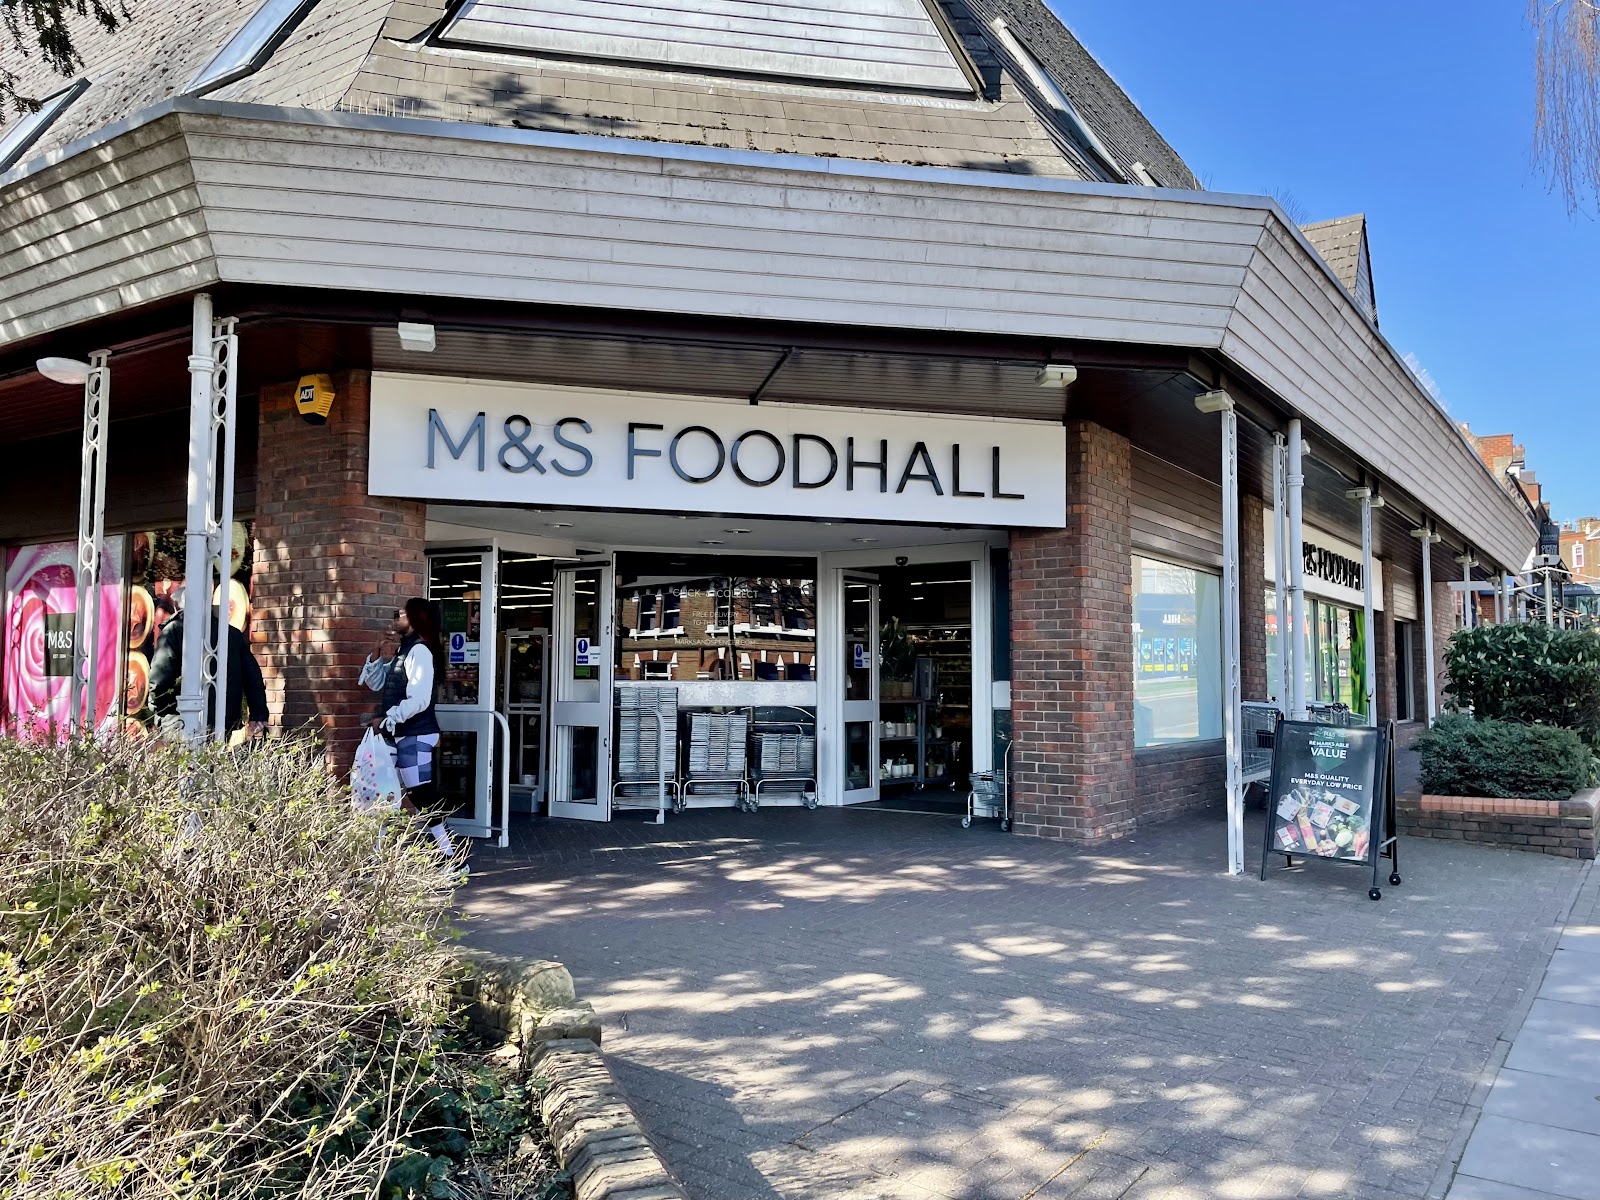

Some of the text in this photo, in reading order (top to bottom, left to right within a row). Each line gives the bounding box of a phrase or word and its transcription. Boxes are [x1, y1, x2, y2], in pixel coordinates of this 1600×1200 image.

[300, 388, 315, 401] ADT
[427, 408, 1025, 499] M&S FOODHALL
[716, 589, 759, 599] COLLECT
[48, 630, 73, 649] M&S
[1310, 746, 1347, 759] VALUE
[1304, 772, 1350, 782] M&S QUALITY
[1290, 777, 1325, 787] EVERYDAY
[1342, 782, 1363, 791] PRICE
